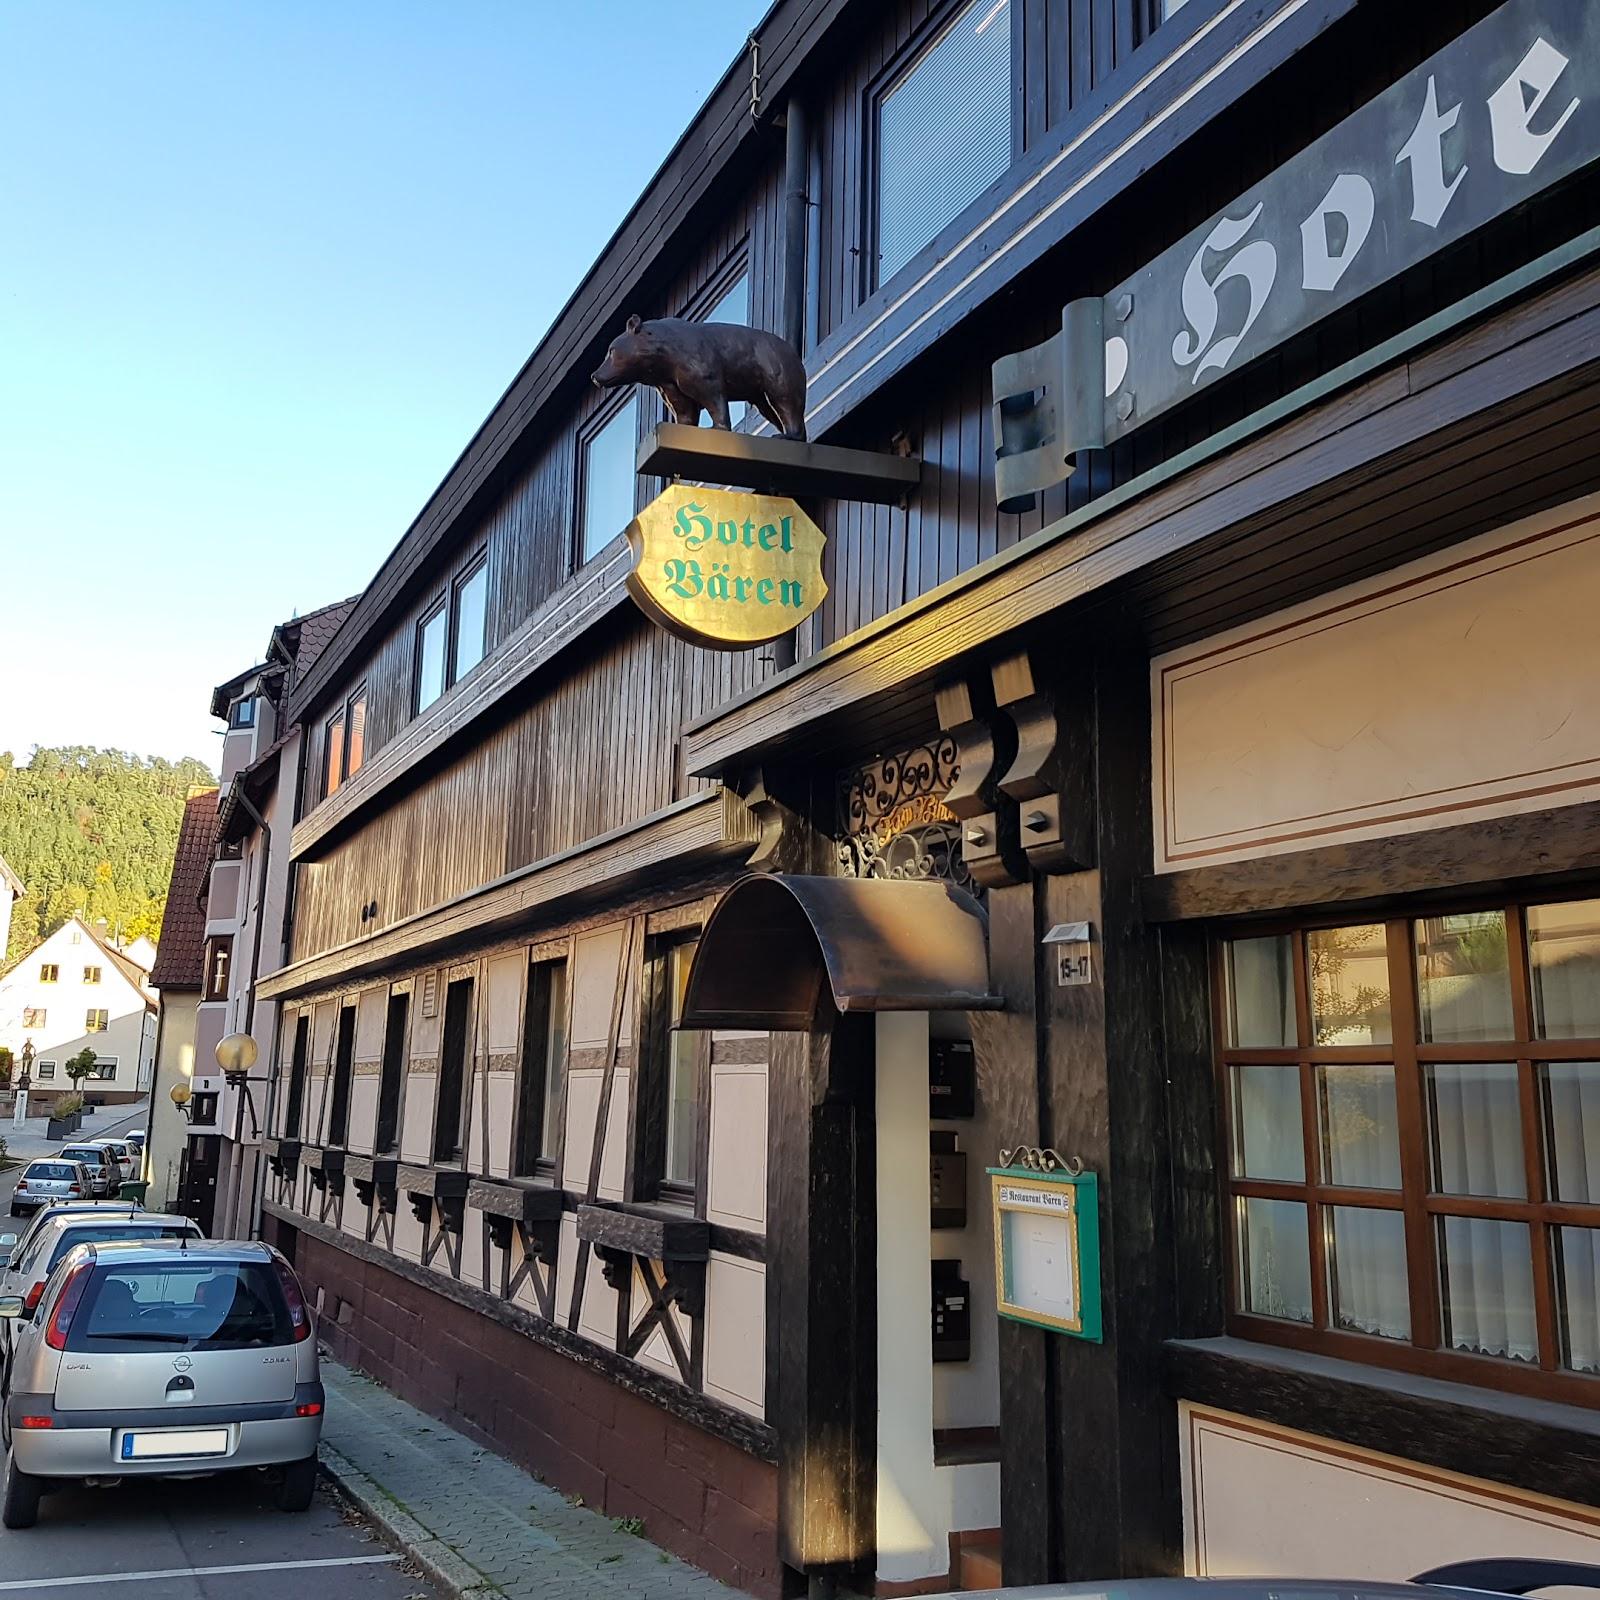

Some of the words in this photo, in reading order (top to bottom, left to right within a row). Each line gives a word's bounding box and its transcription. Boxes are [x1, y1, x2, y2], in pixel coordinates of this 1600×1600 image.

[673, 500, 796, 554] Hotel
[663, 558, 805, 609] Bären
[1060, 955, 1088, 979] 15-17
[1008, 1190, 1041, 1204] Restaurant
[1042, 1193, 1062, 1206] Bären
